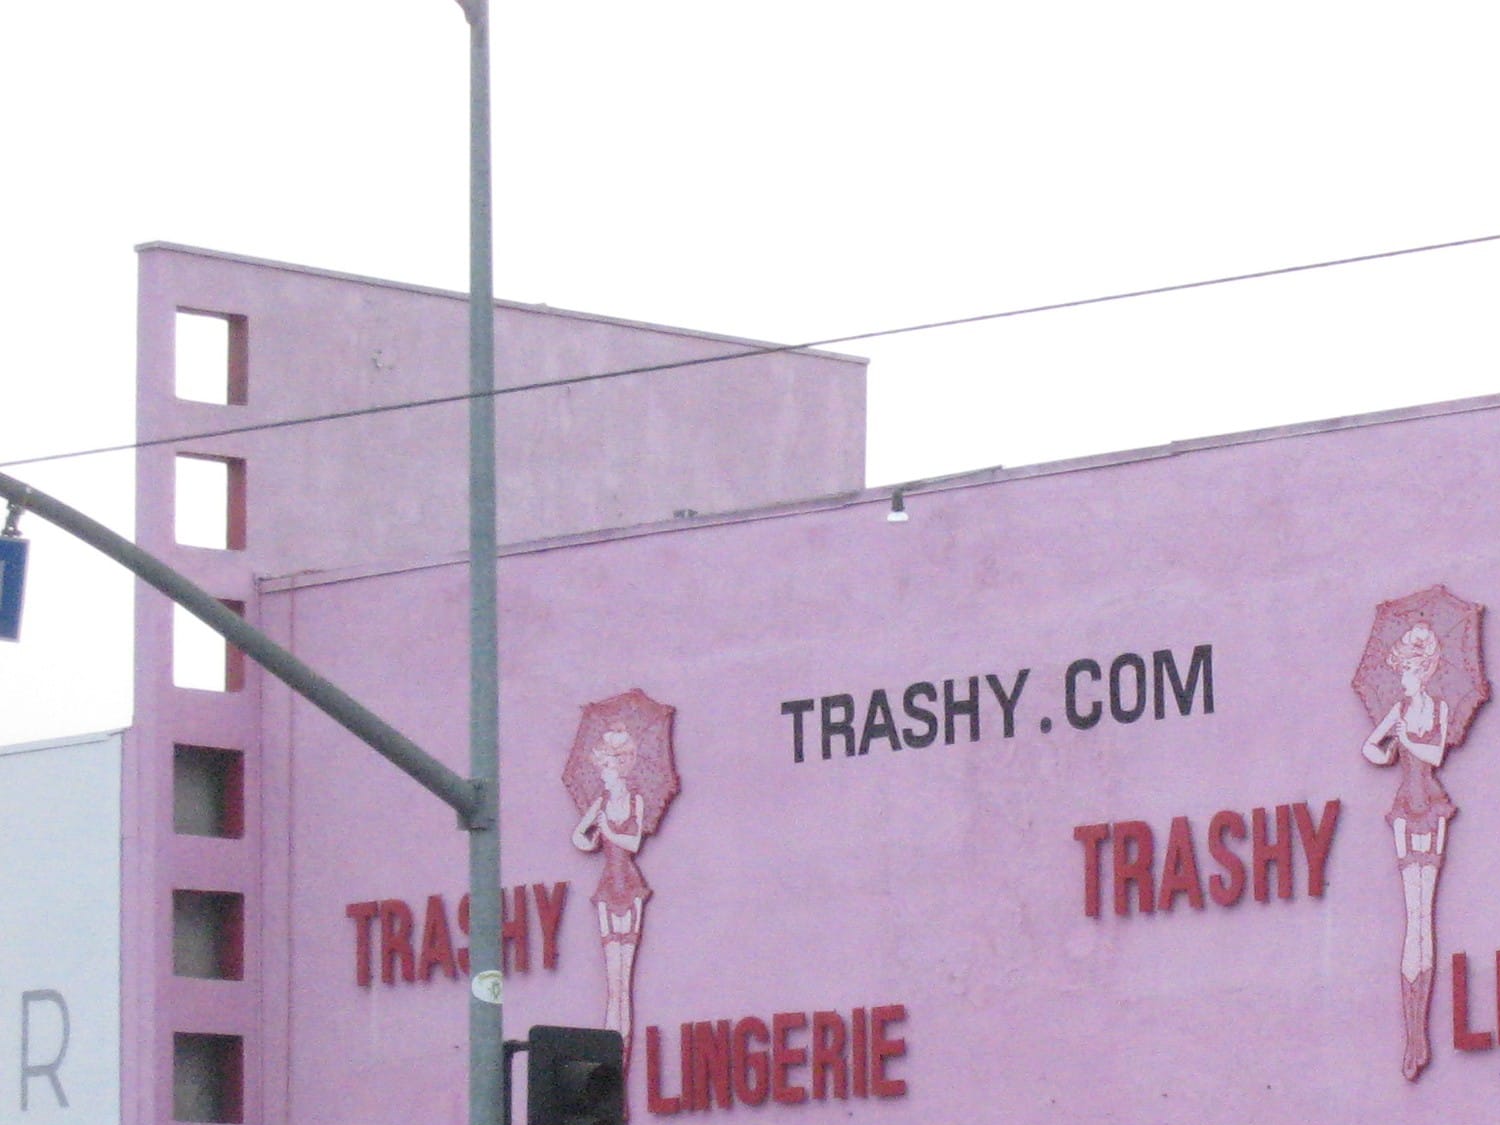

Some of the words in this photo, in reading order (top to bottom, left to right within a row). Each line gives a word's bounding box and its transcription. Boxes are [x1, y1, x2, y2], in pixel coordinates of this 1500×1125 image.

[781, 644, 1215, 763] TRASHY.COM
[1074, 799, 1340, 918] TRASHY
[20, 989, 70, 1111] R
[646, 1004, 905, 1114] LINGERIE
